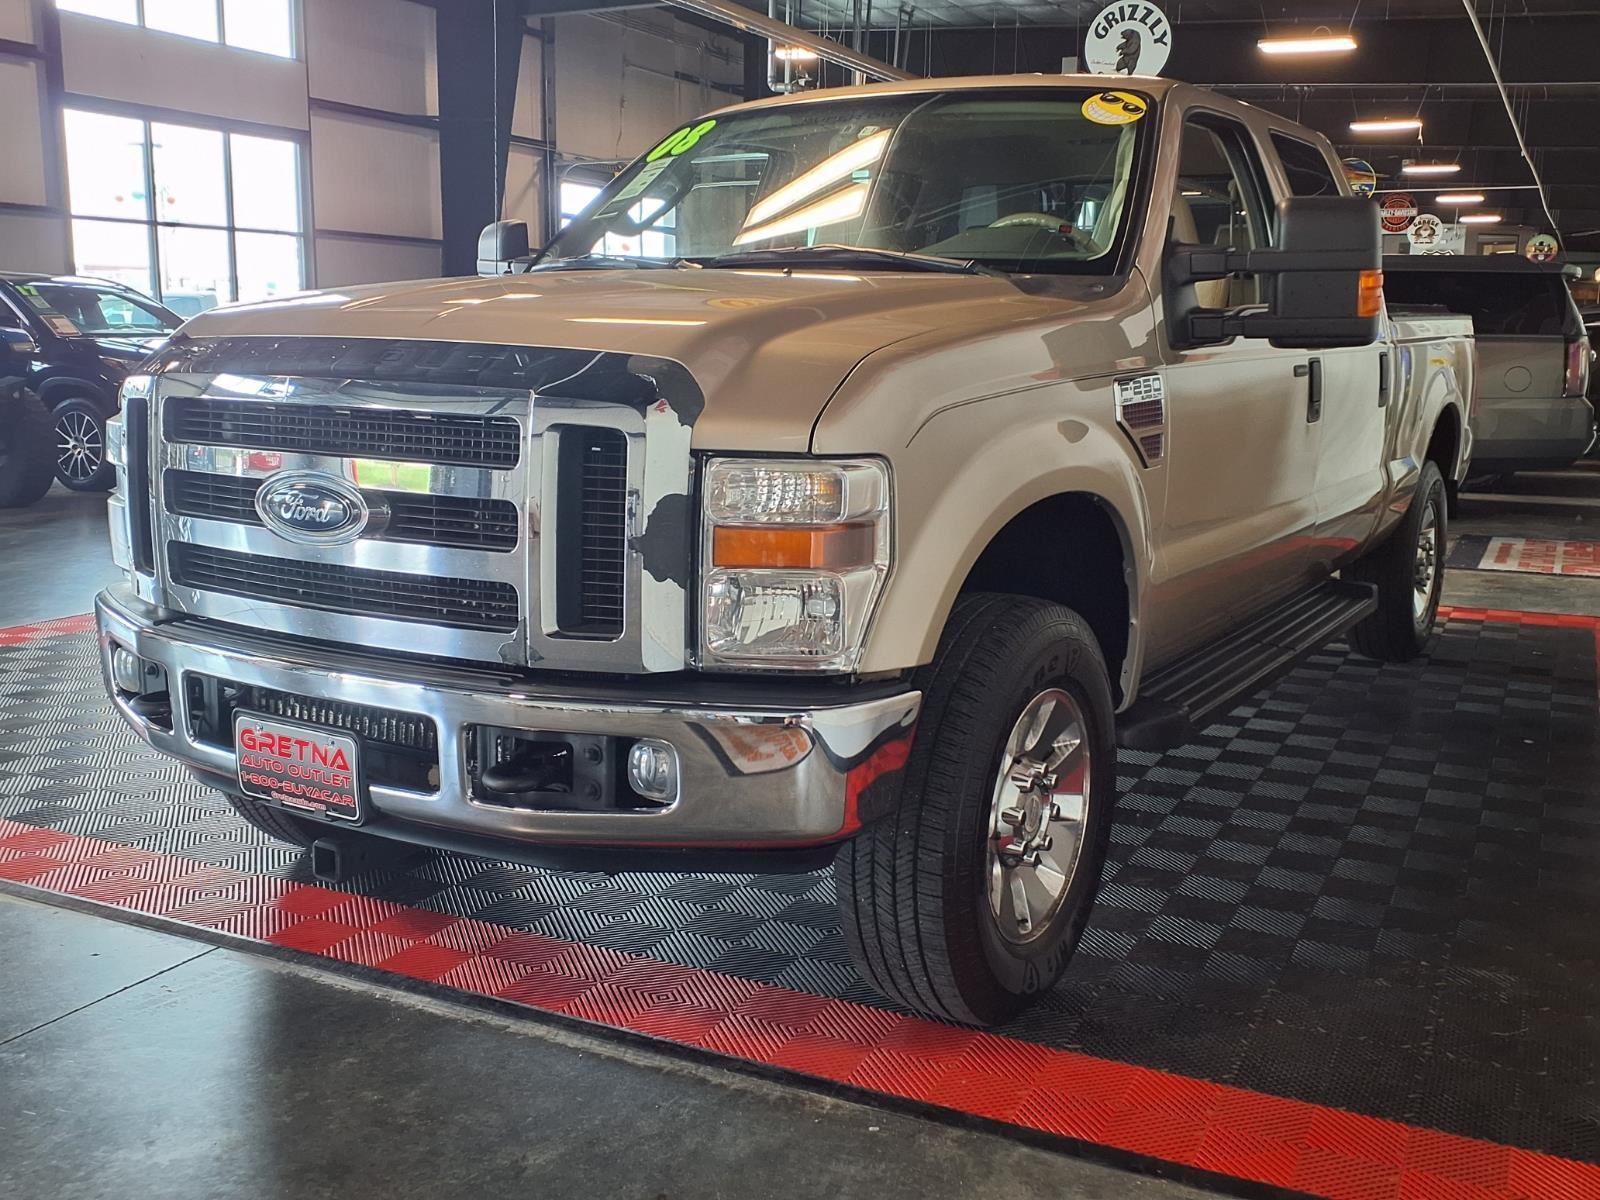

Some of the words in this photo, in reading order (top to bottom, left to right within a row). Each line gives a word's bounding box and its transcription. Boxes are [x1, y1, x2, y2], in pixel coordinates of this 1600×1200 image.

[1094, 4, 1168, 47] GRIZZLY
[646, 119, 717, 163] 08
[1413, 219, 1439, 227] GARAGE
[267, 489, 331, 523] Ford
[240, 728, 350, 771] GRETNA
[240, 754, 284, 774] AUTO
[287, 764, 353, 789] OUTLET
[240, 771, 355, 808] 1-800-BUYACAR
